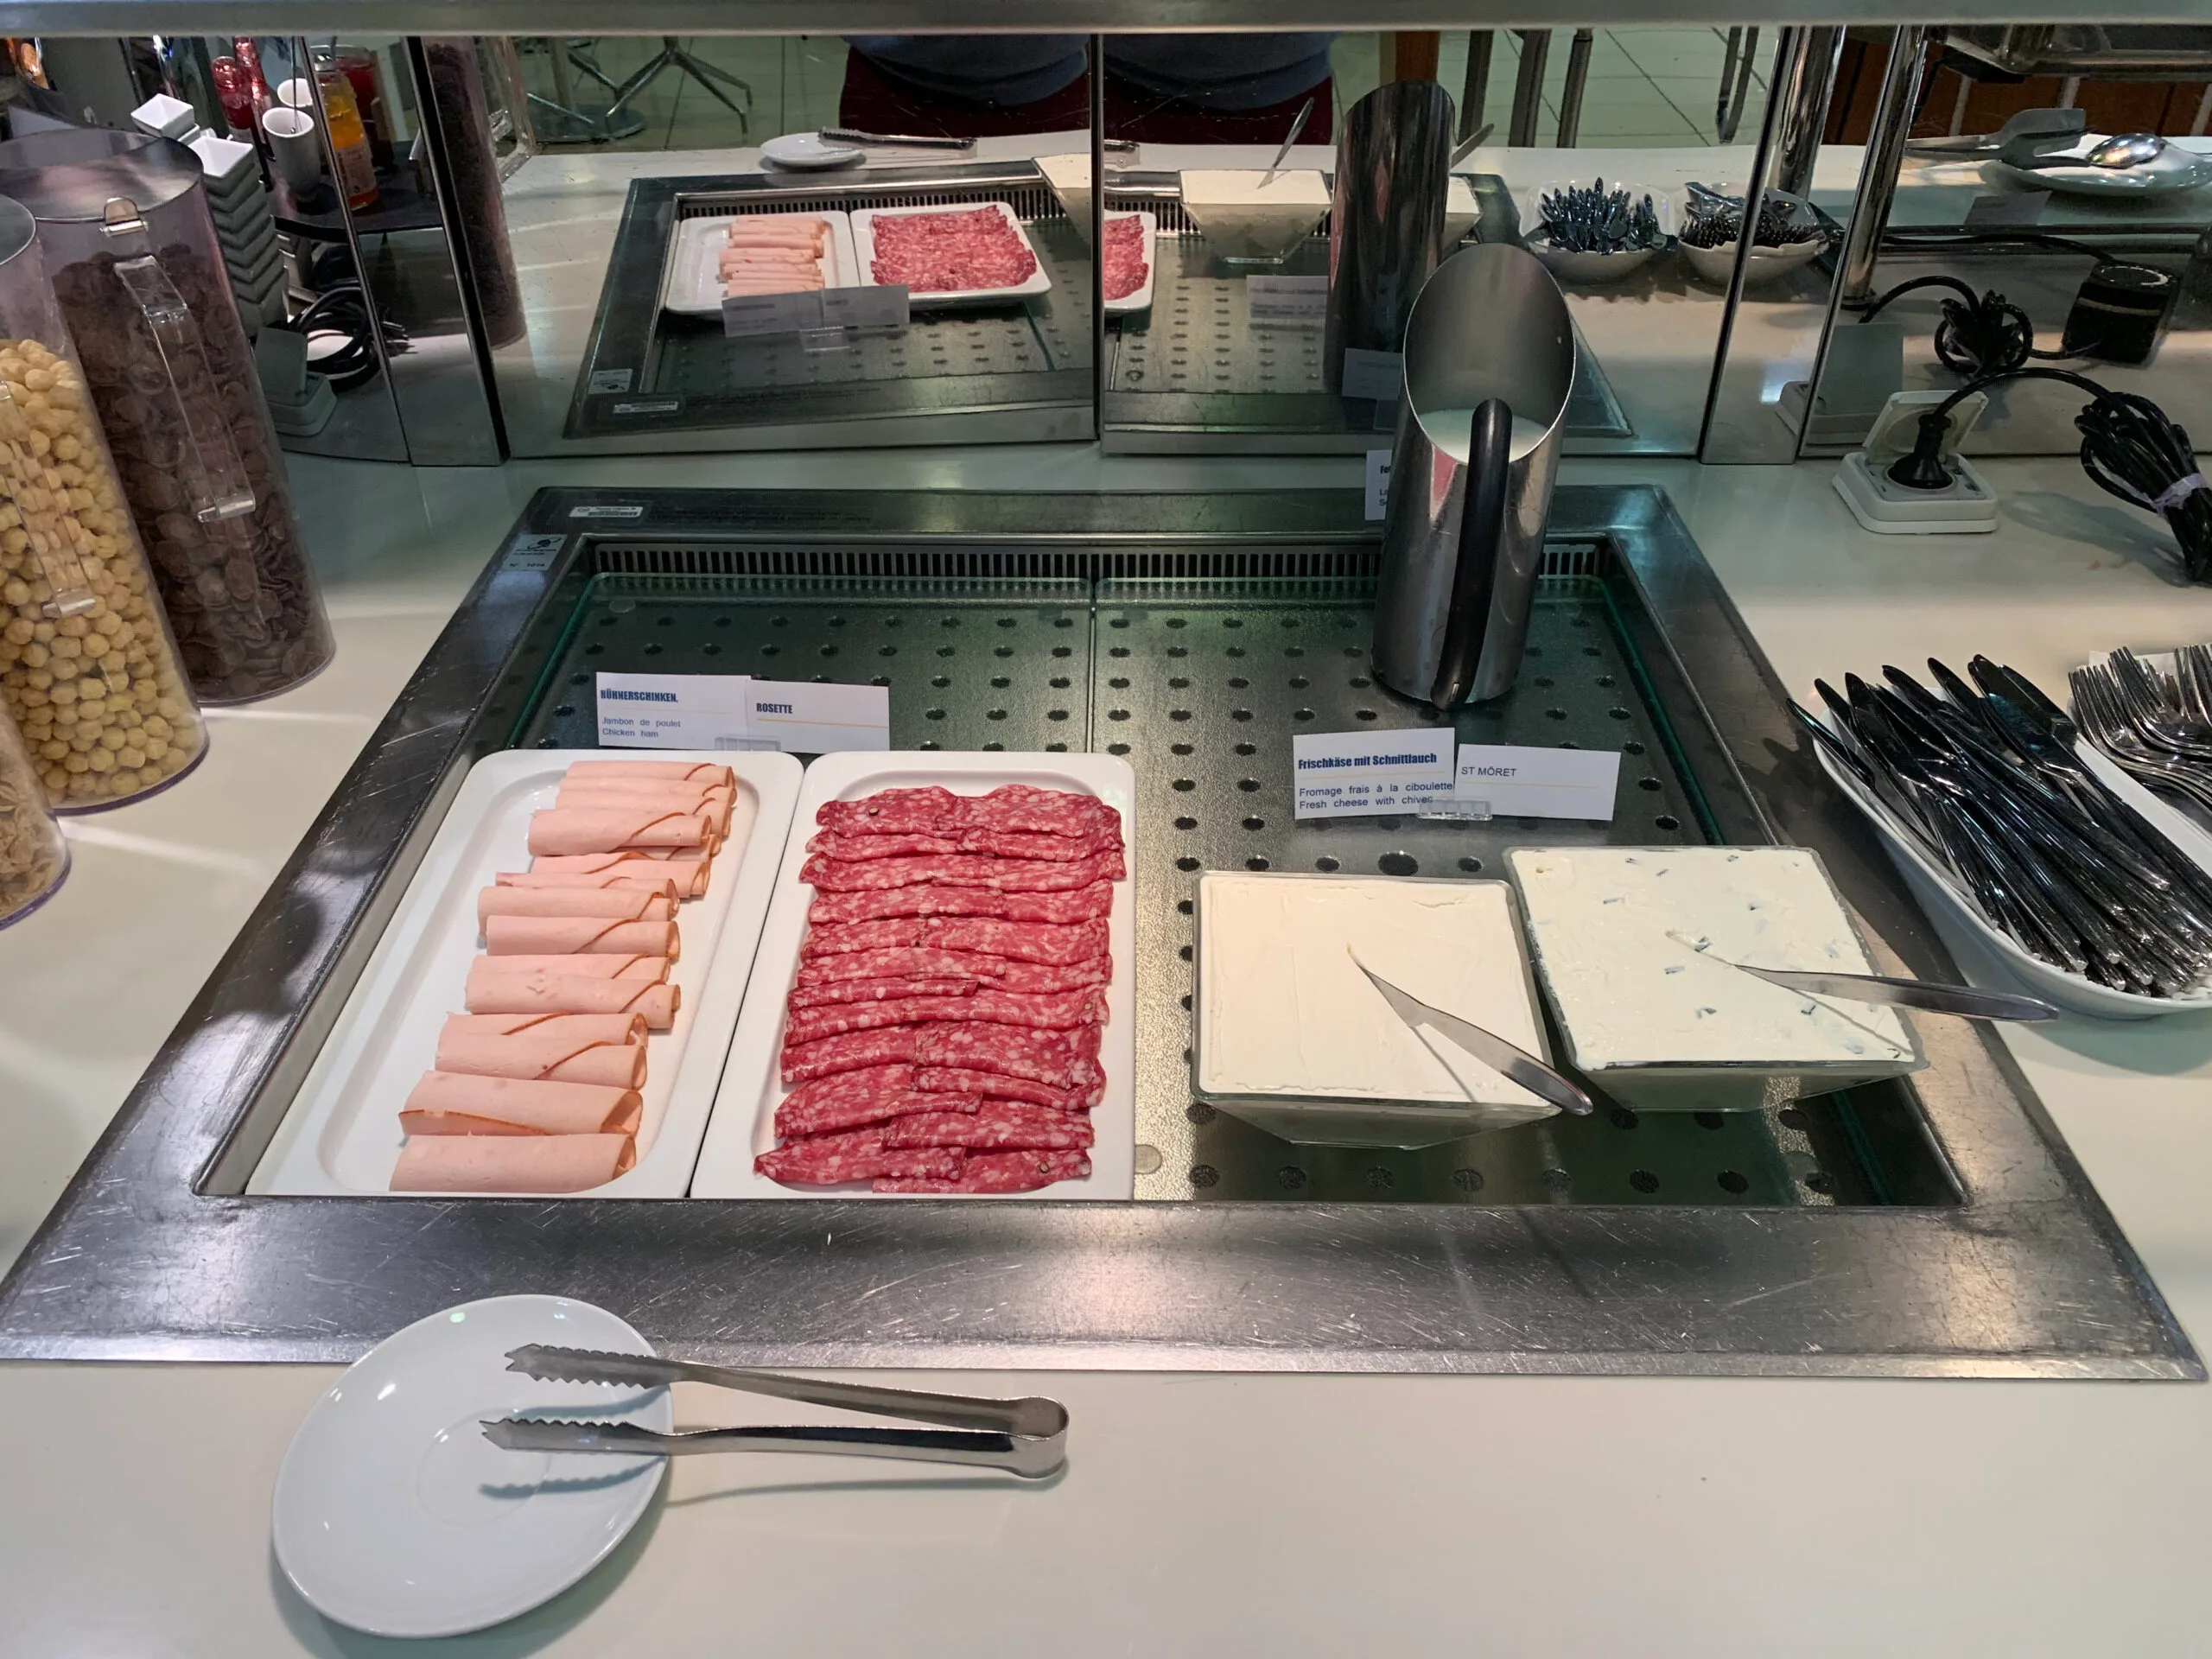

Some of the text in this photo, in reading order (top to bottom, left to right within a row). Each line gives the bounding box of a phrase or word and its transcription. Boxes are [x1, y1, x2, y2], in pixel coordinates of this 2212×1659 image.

[756, 702, 792, 715] ROSETTE
[602, 717, 634, 726] Jambon
[602, 728, 658, 738] Chicken ham
[1298, 753, 1437, 770] Frischkäse mit Schnittlauch
[1461, 766, 1475, 775] ST
[1300, 787, 1343, 798] Fromage
[1349, 785, 1370, 794] frais
[1389, 784, 1398, 792] la
[1406, 782, 1452, 791] ciboulette
[1300, 800, 1327, 810] Fresh
[1333, 798, 1369, 808] cheese
[1376, 797, 1395, 805] with
